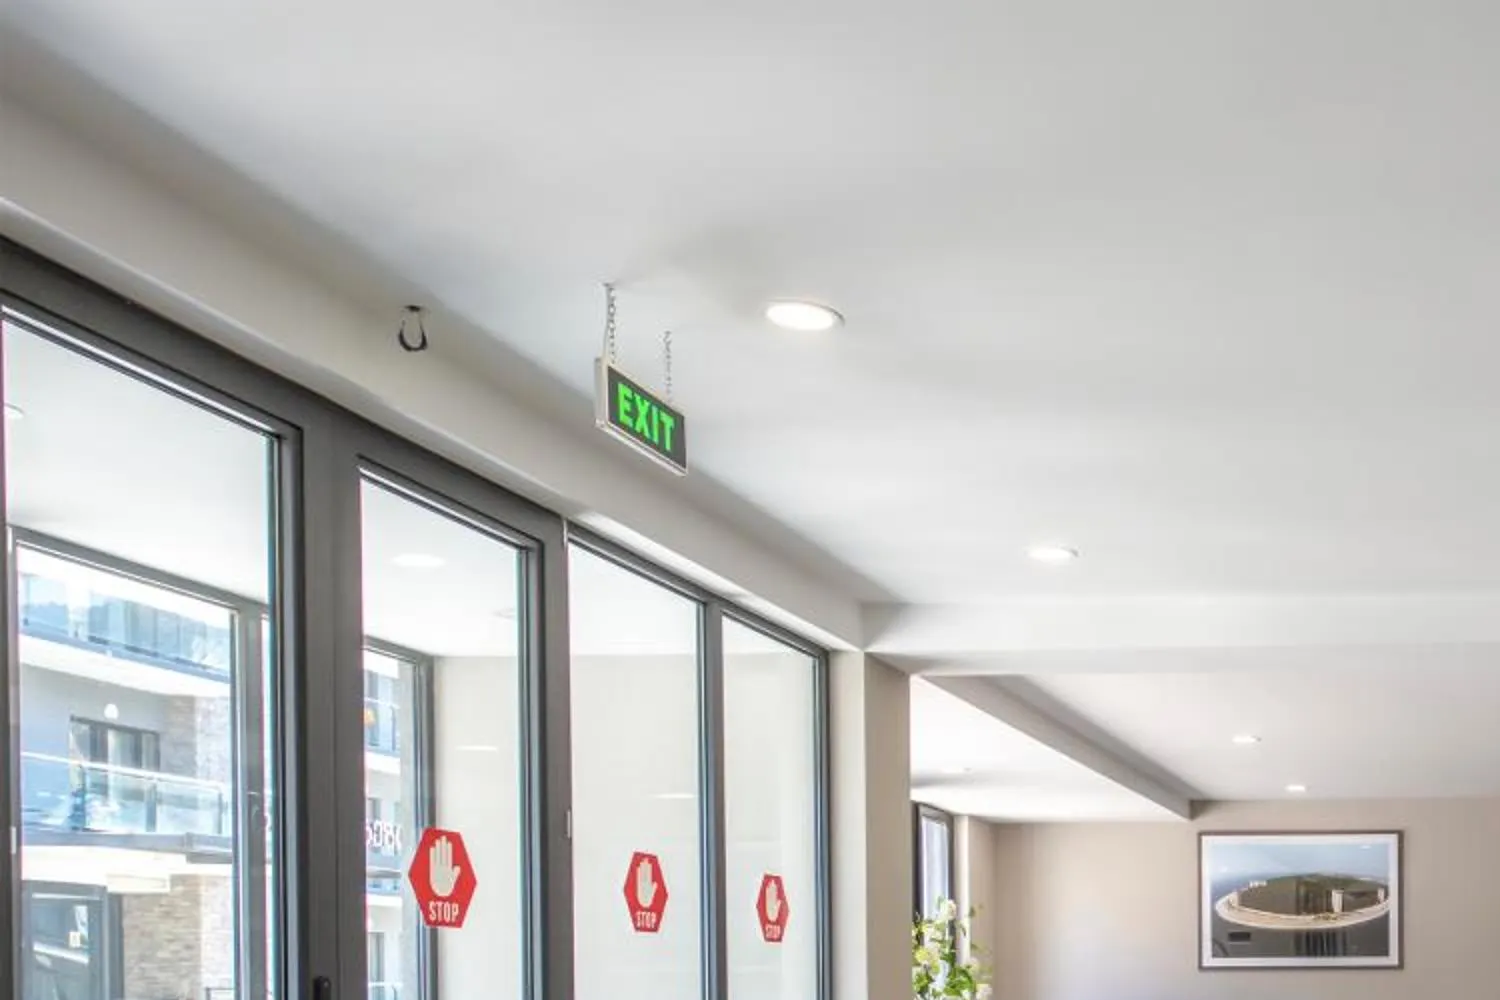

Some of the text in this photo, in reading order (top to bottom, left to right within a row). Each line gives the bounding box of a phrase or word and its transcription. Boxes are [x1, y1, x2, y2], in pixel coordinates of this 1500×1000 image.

[617, 382, 675, 451] EXIT
[429, 901, 459, 922] STOP
[635, 911, 657, 929] STOP
